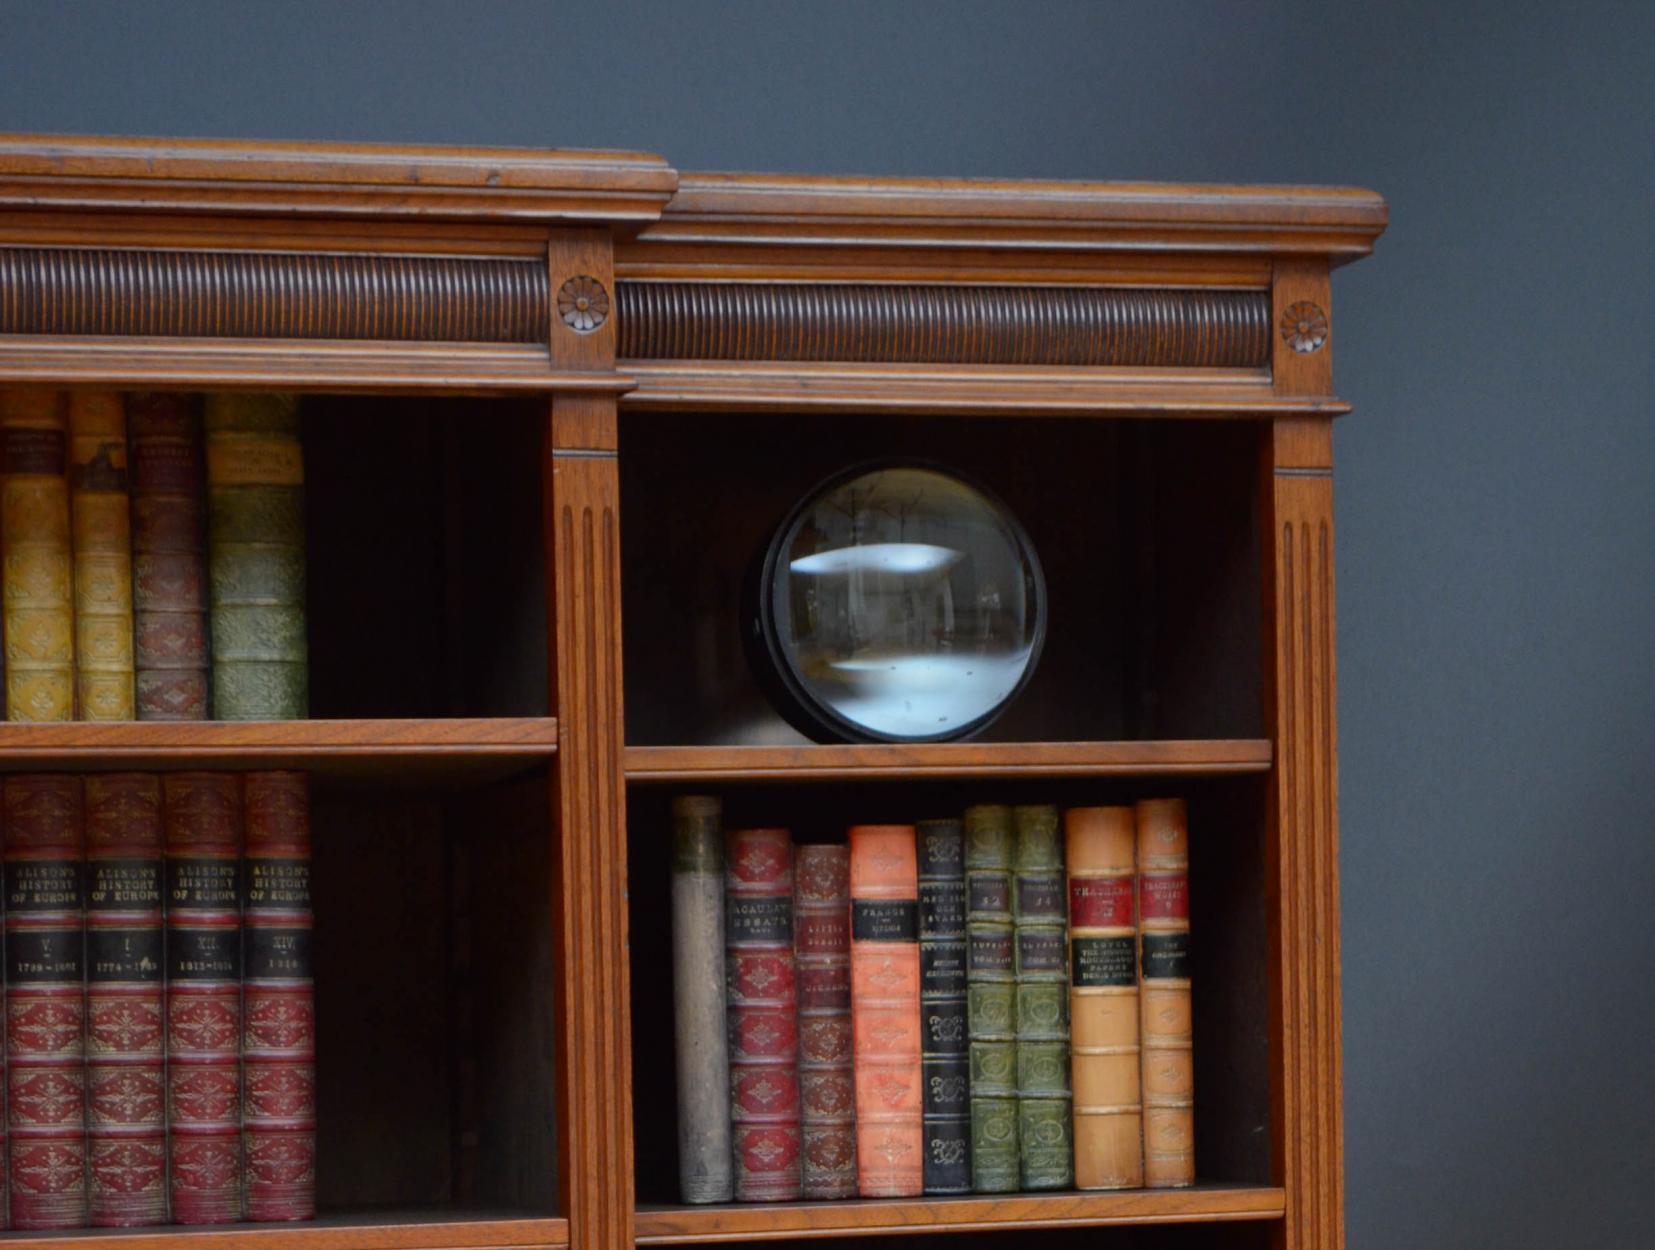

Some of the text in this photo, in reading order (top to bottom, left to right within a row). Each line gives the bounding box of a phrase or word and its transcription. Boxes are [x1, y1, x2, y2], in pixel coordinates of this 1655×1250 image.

[92, 891, 107, 902] OF
[173, 890, 188, 900] OF
[251, 890, 265, 900] OF
